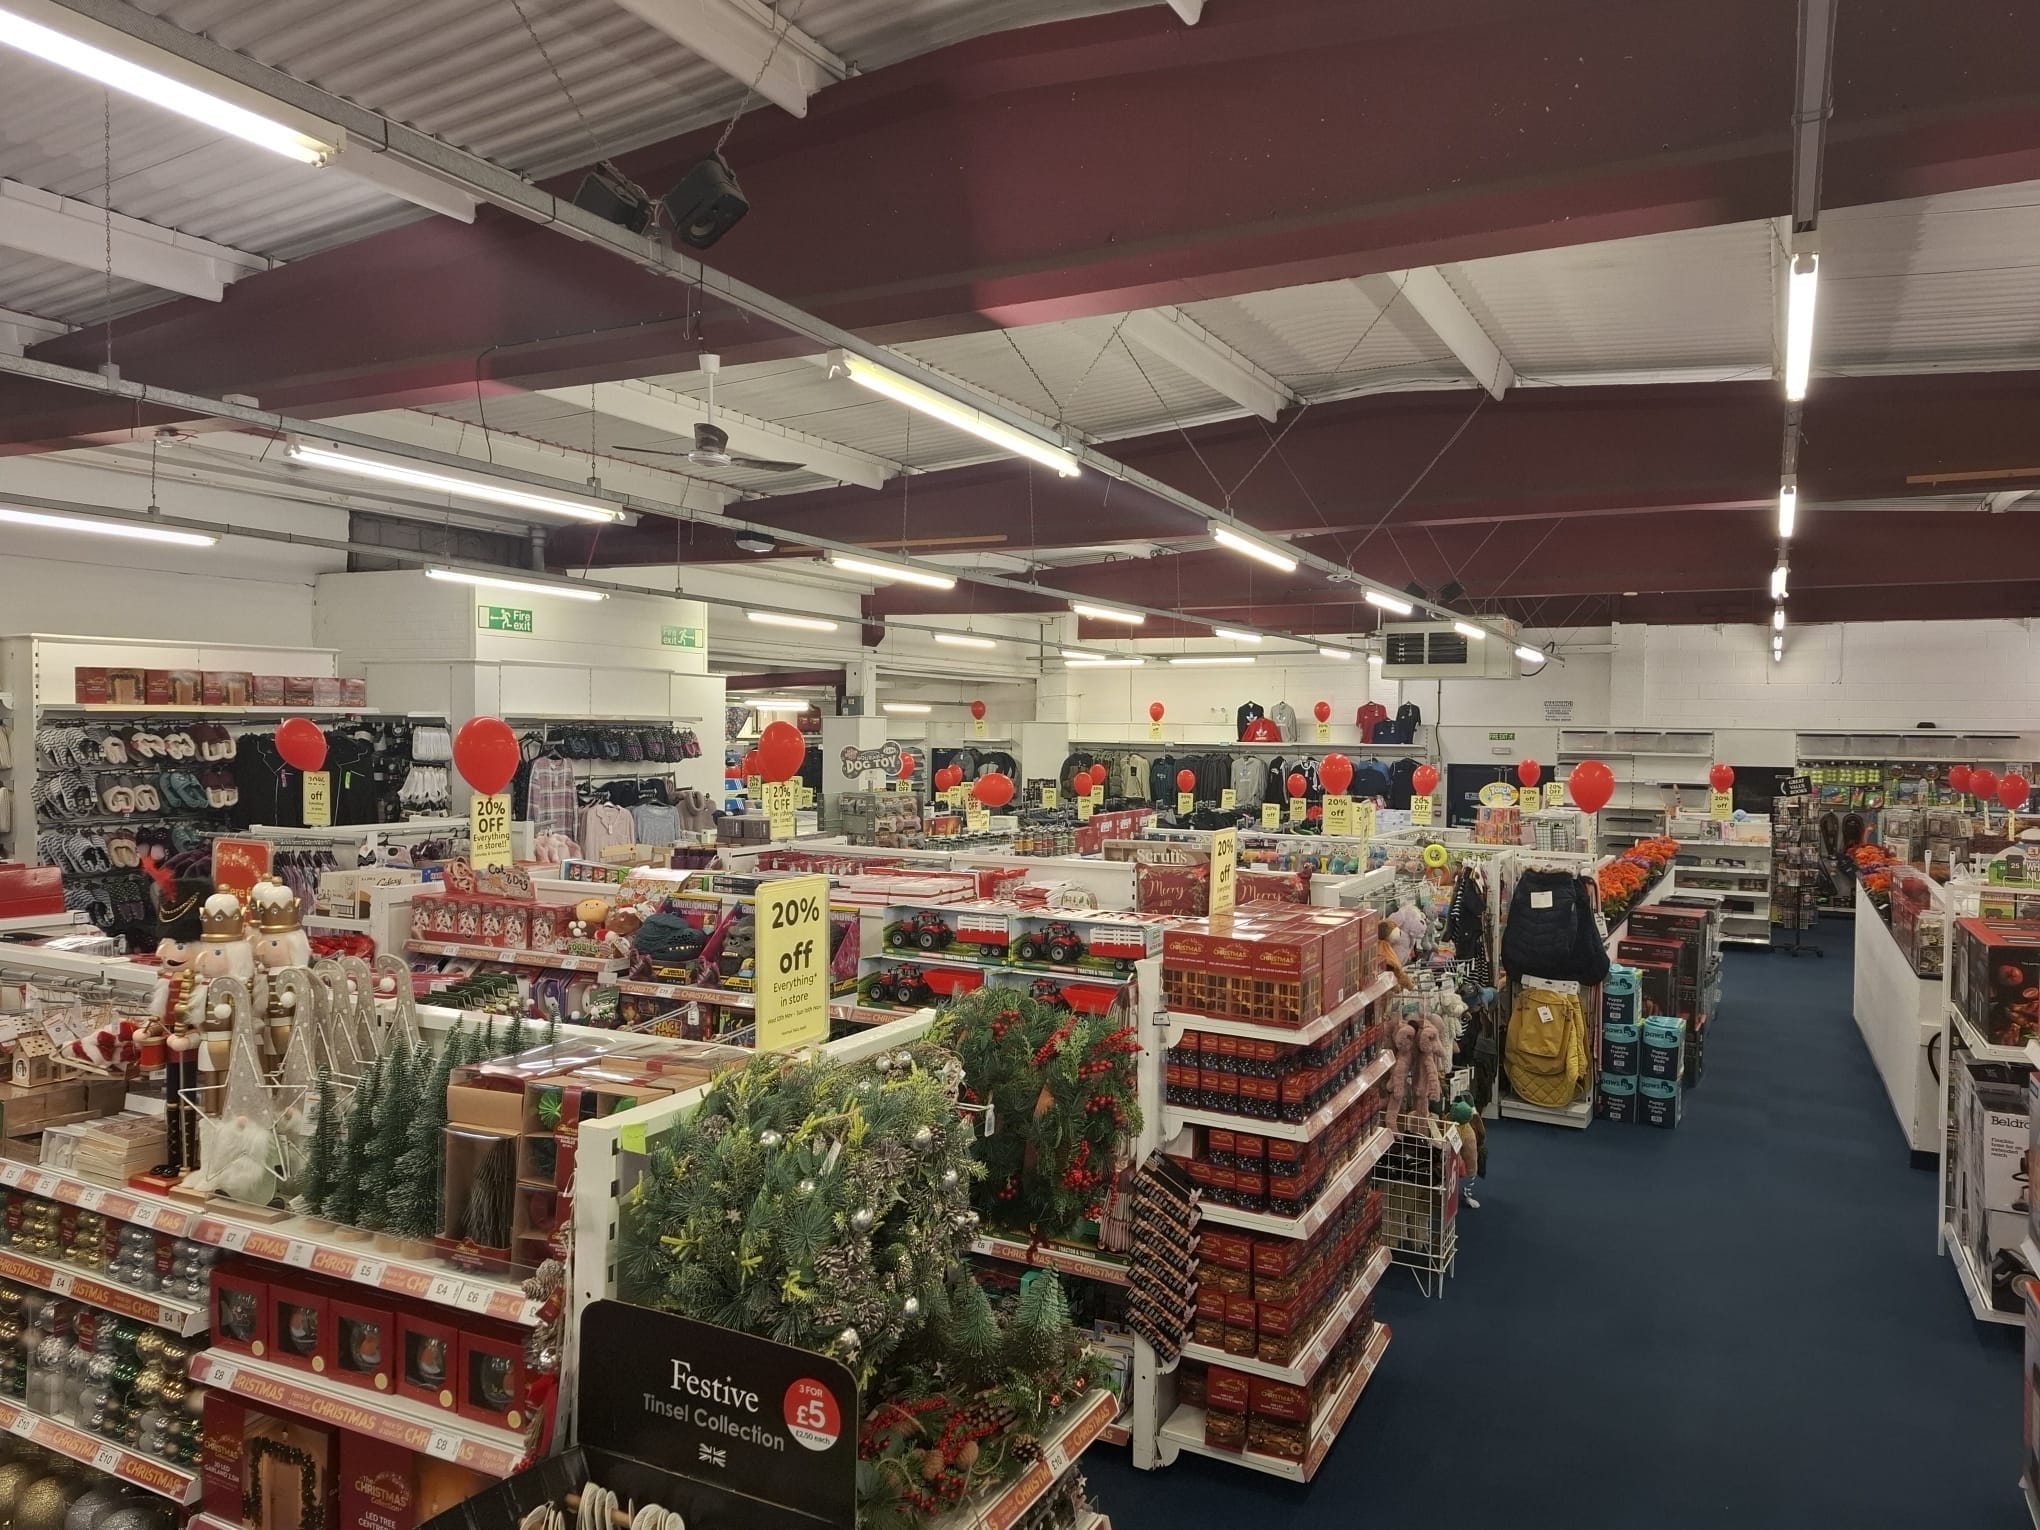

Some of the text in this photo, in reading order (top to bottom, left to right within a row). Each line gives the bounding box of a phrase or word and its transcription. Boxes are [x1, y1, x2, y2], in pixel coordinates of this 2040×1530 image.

[513, 611, 531, 622] Fire
[513, 622, 531, 632] exit
[663, 637, 677, 645] exit
[846, 755, 897, 774] DOG TOY
[310, 791, 323, 800] off
[773, 787, 791, 797] 20%
[477, 801, 506, 816] 20%
[773, 800, 791, 811] OFF
[478, 817, 504, 833] OFF
[473, 832, 510, 843] Everything
[477, 842, 483, 850] in
[1217, 840, 1234, 856] 20%
[1136, 849, 1188, 864] Scruffs
[1220, 864, 1231, 883] off
[1150, 881, 1184, 900] Merry
[1241, 885, 1283, 902] Merry
[771, 896, 820, 929] 20%
[779, 940, 813, 974] off
[1260, 953, 1294, 963] CHRISTMAS
[681, 990, 721, 1002] CHRISTMAS
[780, 992, 809, 1007] in store
[1605, 1027, 1623, 1035] paws
[1645, 1032, 1665, 1040] paws
[1601, 1079, 1621, 1088] paws
[138, 1208, 151, 1220] £20
[226, 1231, 237, 1242] £7
[360, 1265, 372, 1277] £5
[436, 1283, 448, 1295] £4
[467, 1291, 480, 1303] £6
[1002, 1247, 1051, 1265] CHRISMAS
[1074, 1263, 1126, 1282] CHRISTMAS
[56, 1277, 65, 1288] £4
[164, 1311, 174, 1323] £4
[669, 1358, 760, 1413] Festive
[799, 1384, 823, 1398] 3 FOR
[214, 1368, 225, 1381] £8
[311, 1399, 378, 1430] CHRISTMAS
[435, 1437, 448, 1450] £8
[796, 1400, 826, 1429] £5
[643, 1393, 785, 1452] Tinsel Collection
[1073, 1405, 1110, 1447] CHRISTMAS
[795, 1430, 831, 1446] £2.50 each
[17, 1418, 30, 1431] £10
[98, 1451, 113, 1466] £10
[125, 1461, 183, 1490] CHRISTMAS
[1051, 1456, 1063, 1471] £10
[354, 1480, 408, 1507] CHRISTMAS
[365, 1511, 398, 1529] LED TREE
